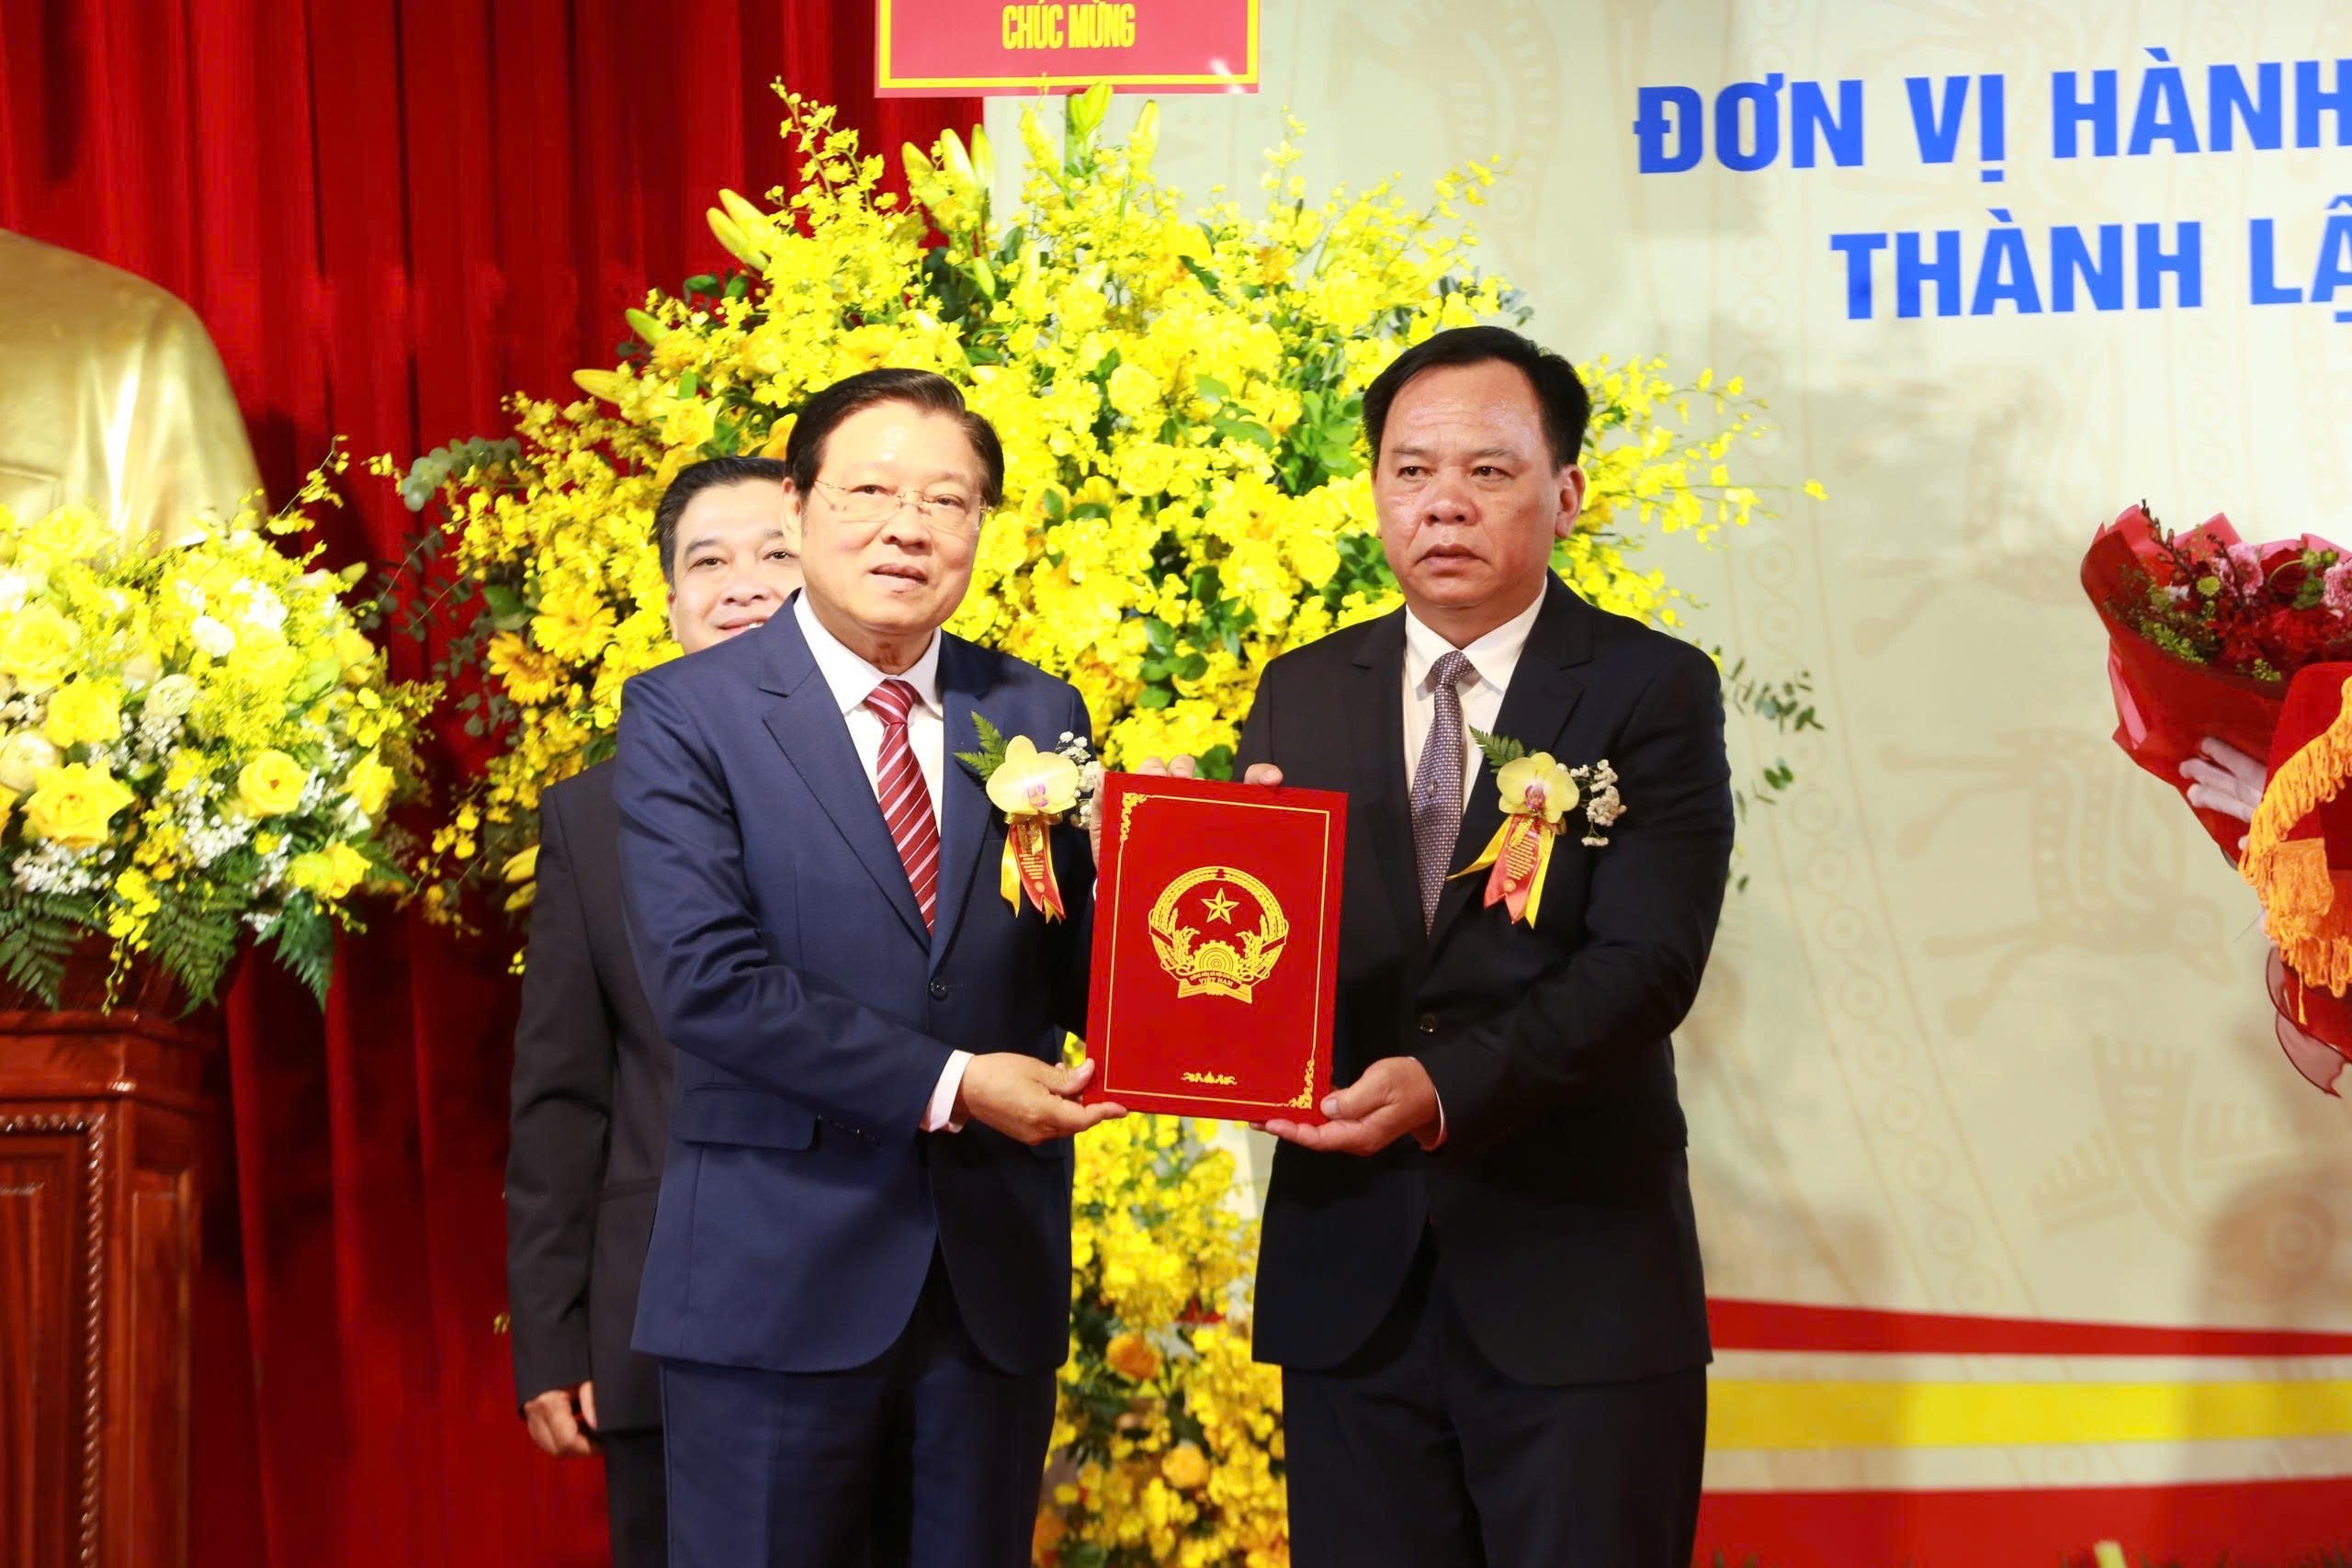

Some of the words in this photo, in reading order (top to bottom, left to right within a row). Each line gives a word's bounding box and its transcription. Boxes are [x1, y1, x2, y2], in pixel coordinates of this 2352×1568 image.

[1002, 0, 1064, 50] CHÚC
[1069, 0, 1136, 49] MỪNG
[1633, 73, 1864, 173] ĐƠN
[1905, 73, 2005, 183] VỊ
[2051, 47, 2352, 159] HÀNH
[1830, 209, 2202, 320] THÀNH
